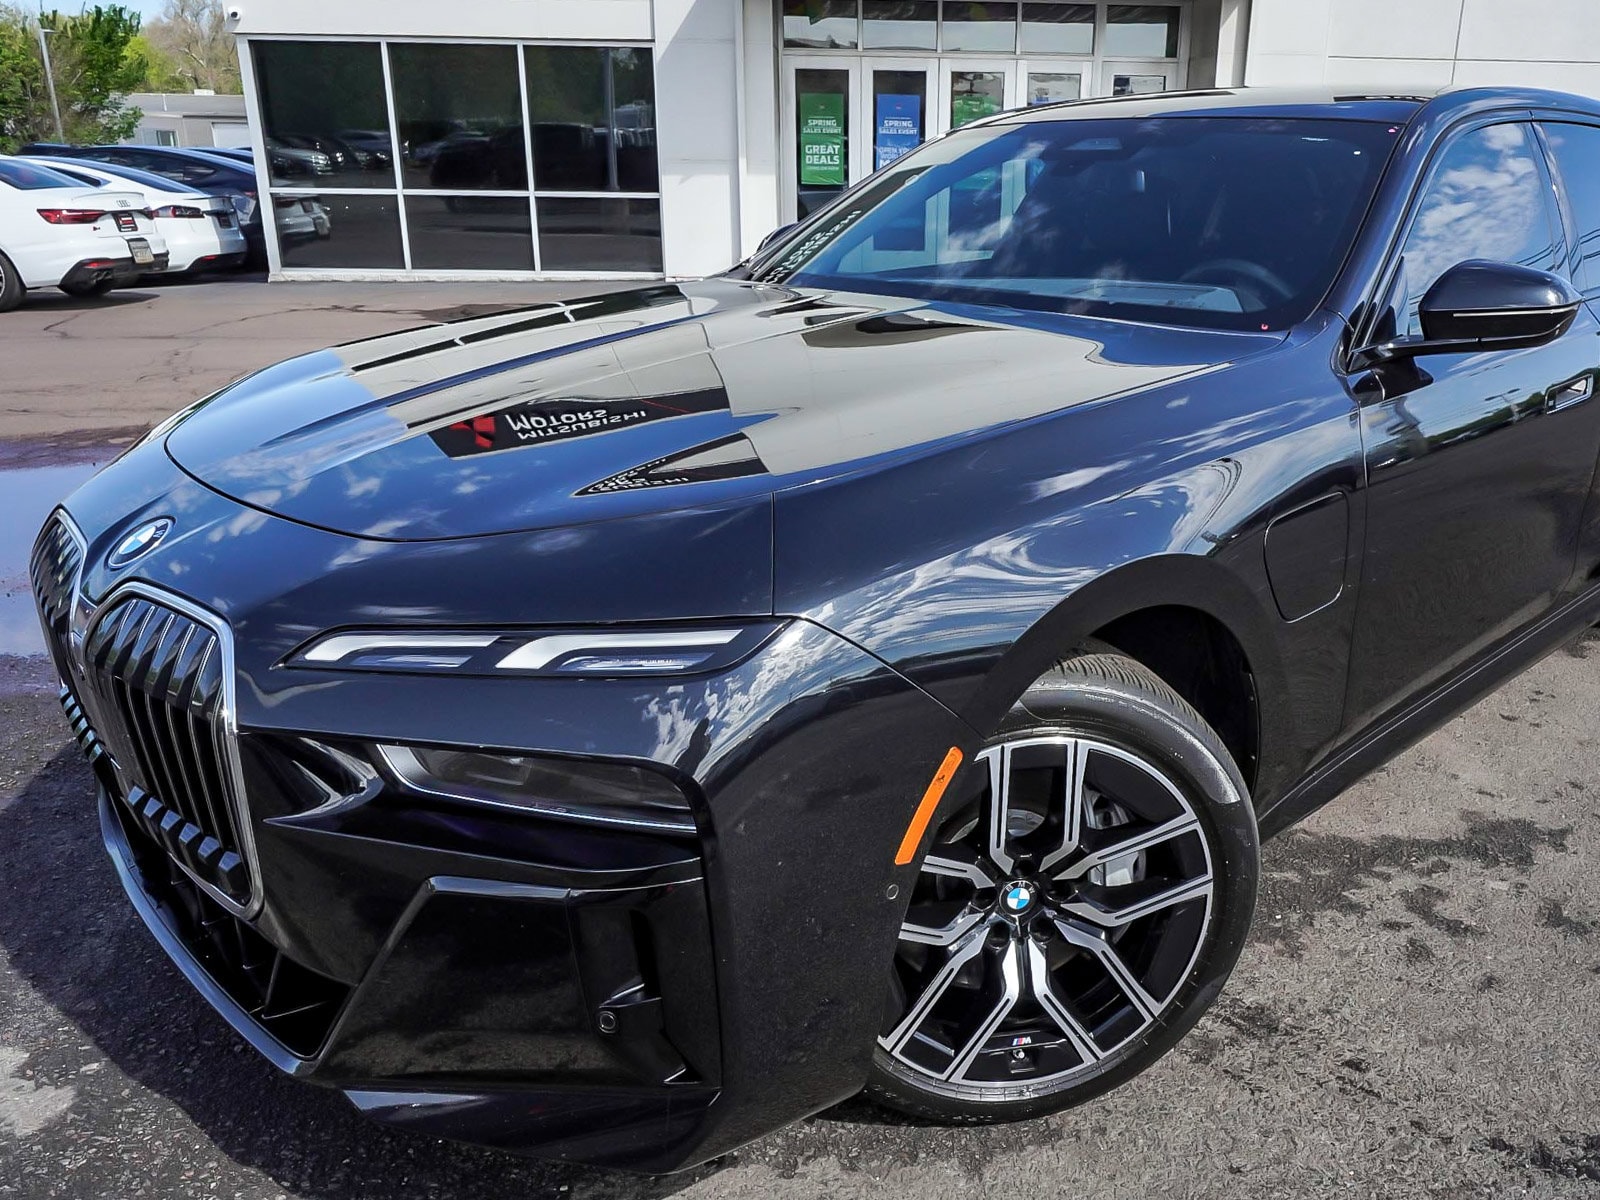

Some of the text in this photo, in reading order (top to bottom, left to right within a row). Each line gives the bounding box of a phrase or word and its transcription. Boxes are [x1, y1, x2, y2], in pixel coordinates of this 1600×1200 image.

[807, 119, 837, 127] SPRING
[805, 144, 841, 155] GREAT
[805, 155, 840, 165] DEALS
